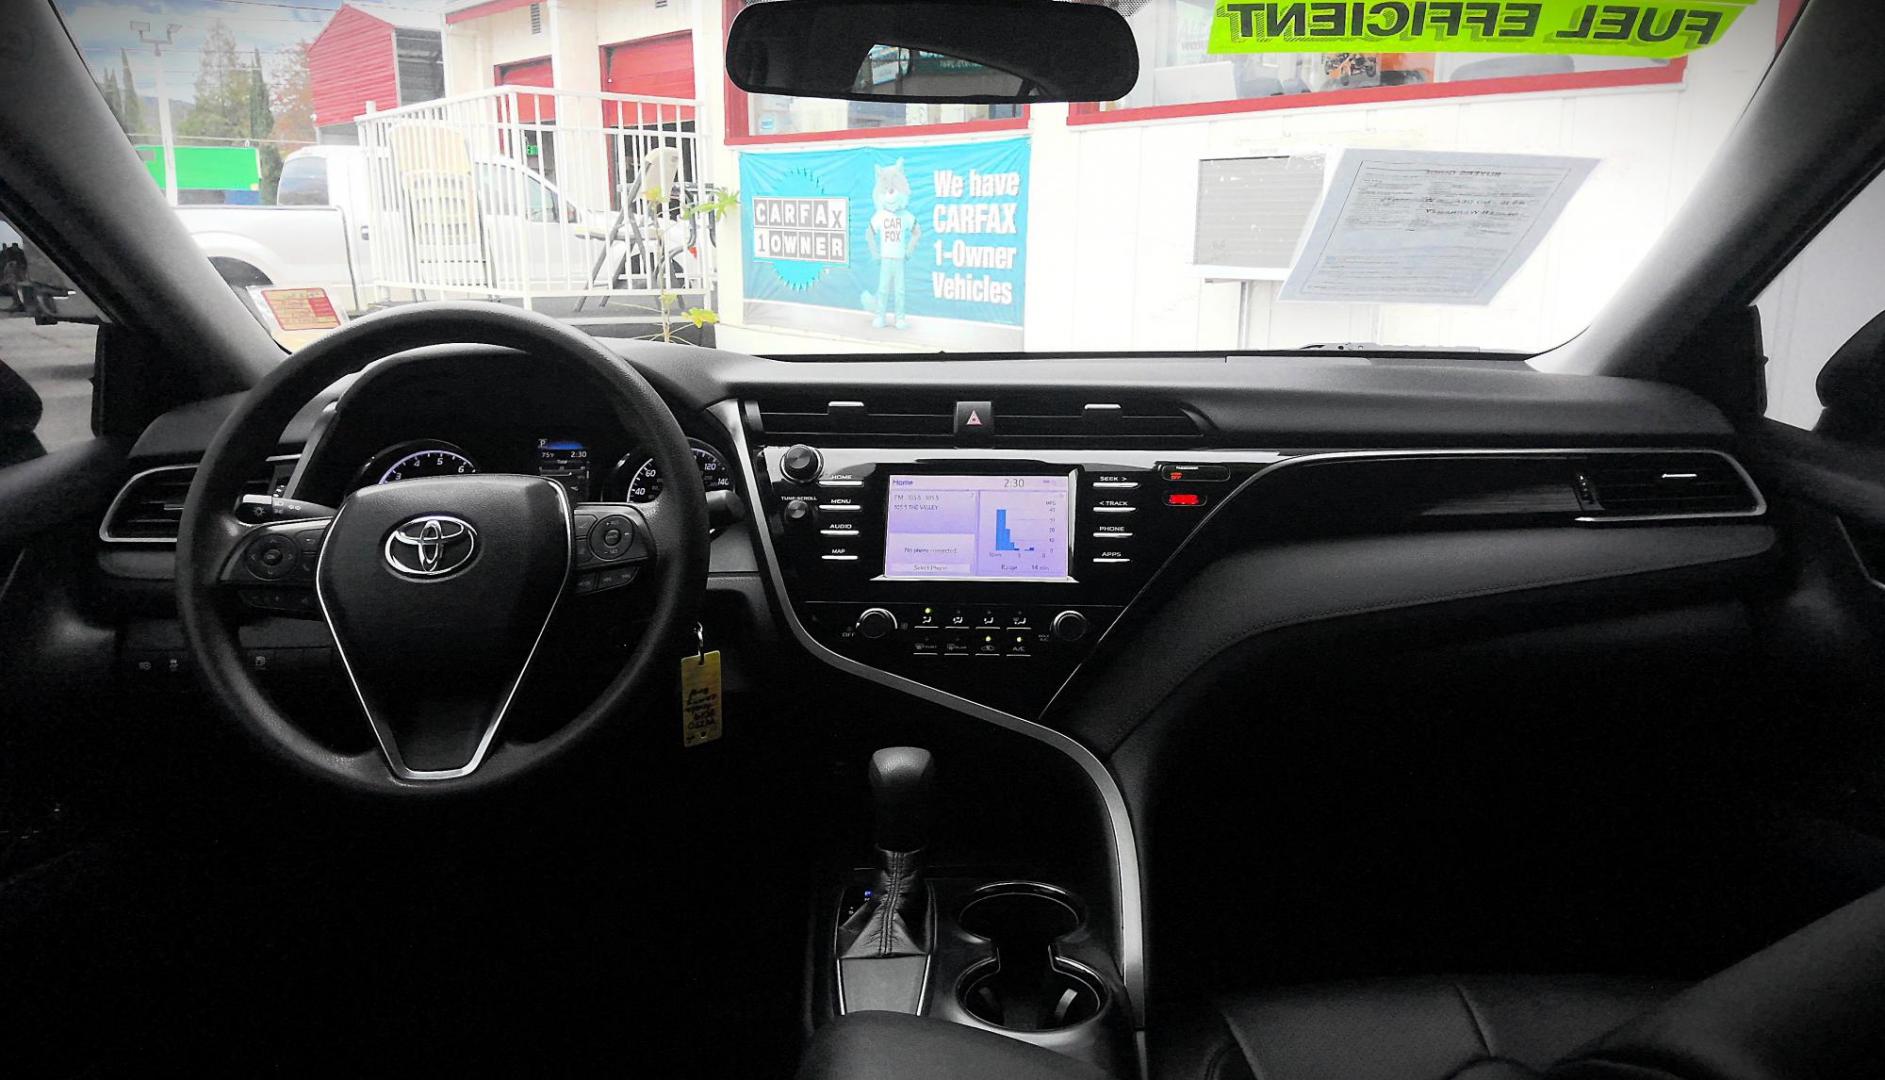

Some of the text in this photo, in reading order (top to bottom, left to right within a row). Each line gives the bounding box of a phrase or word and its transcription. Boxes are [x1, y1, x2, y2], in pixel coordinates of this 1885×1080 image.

[934, 169, 1019, 198] We have
[754, 201, 842, 229] CARFAX
[933, 203, 1018, 234] CARFAX
[883, 217, 902, 230] CAR
[884, 230, 901, 243] FOX
[933, 239, 1017, 270] 1-Owner
[932, 271, 1013, 305] Vehicles
[571, 450, 588, 458] 2:30
[436, 457, 444, 466] 5
[457, 465, 465, 473] 6
[704, 462, 717, 471] 120
[395, 472, 402, 480] 3
[645, 469, 657, 477] 60
[717, 478, 729, 486] 140
[1003, 478, 1025, 488] 2:30
[634, 487, 646, 496] 40
